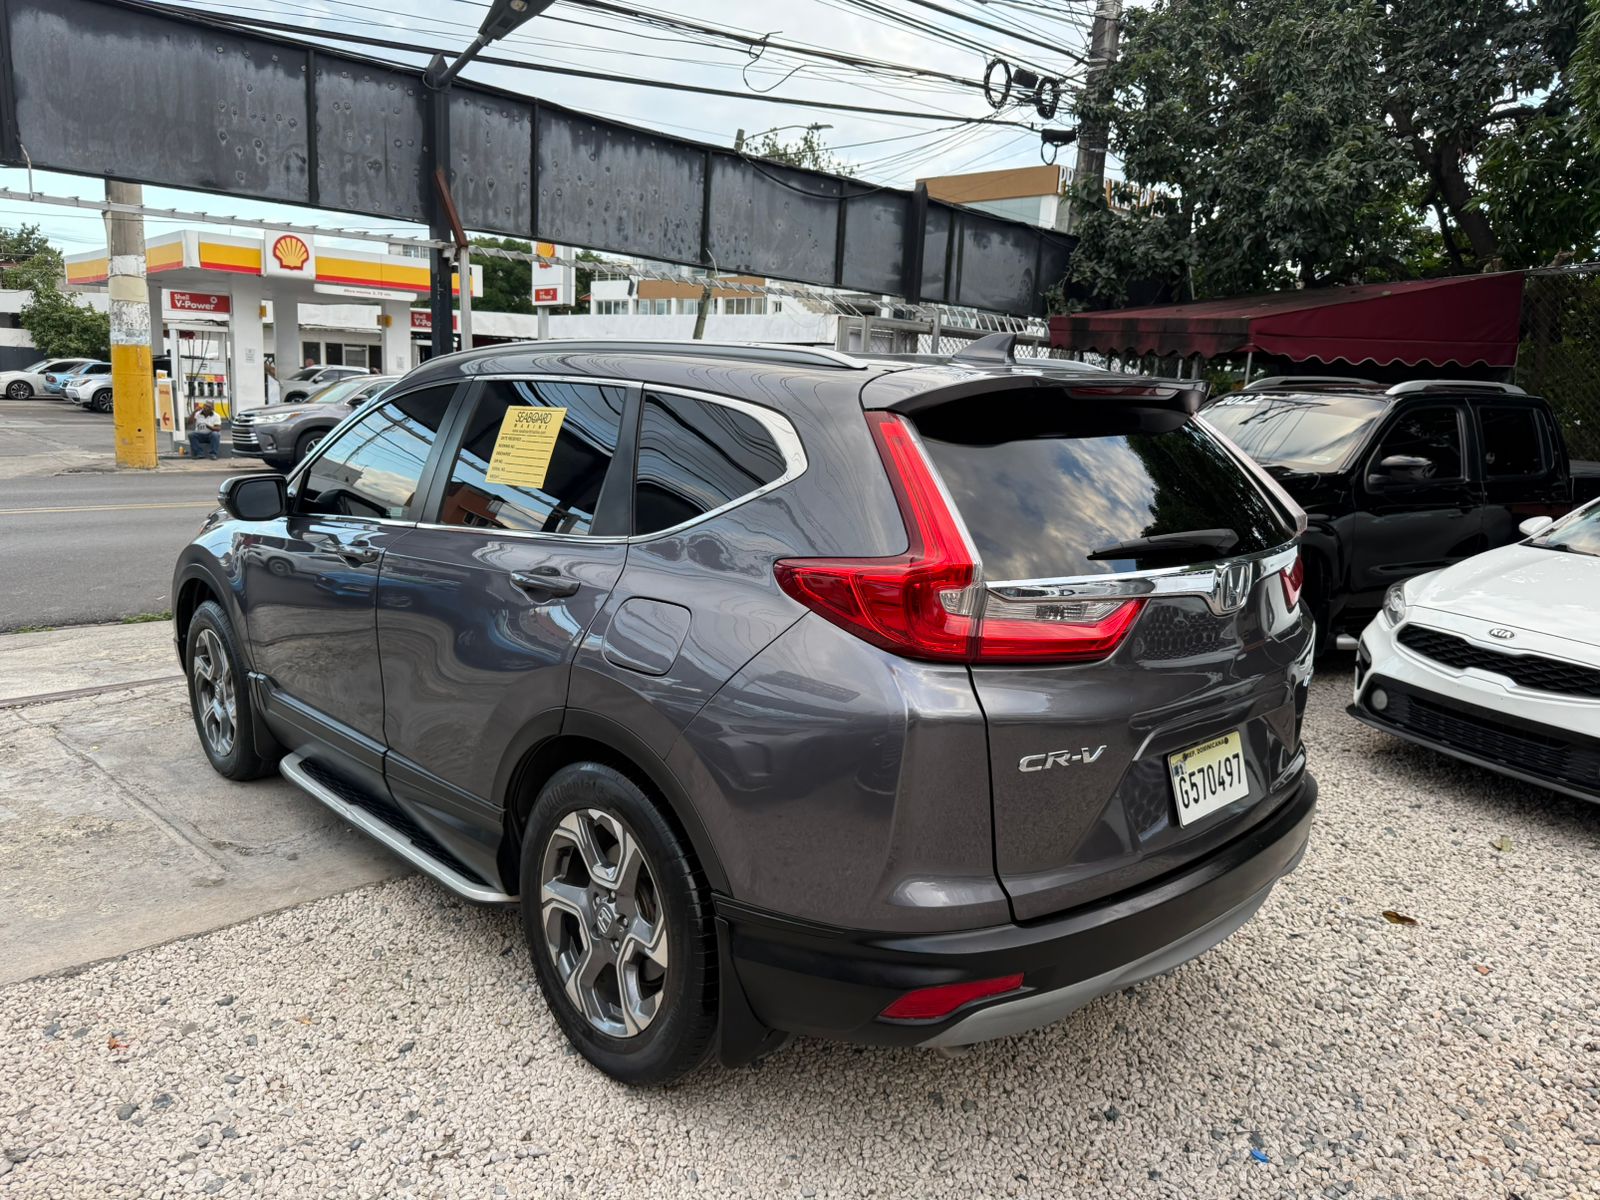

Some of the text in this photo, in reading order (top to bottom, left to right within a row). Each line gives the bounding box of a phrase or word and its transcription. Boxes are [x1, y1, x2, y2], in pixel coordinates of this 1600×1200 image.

[175, 300, 215, 310] V-Power
[415, 319, 432, 327] V-Po
[515, 411, 552, 424] SEABOARD
[1490, 629, 1513, 639] KIA
[1018, 745, 1107, 772] CR-V
[1179, 752, 1242, 809] G570497
